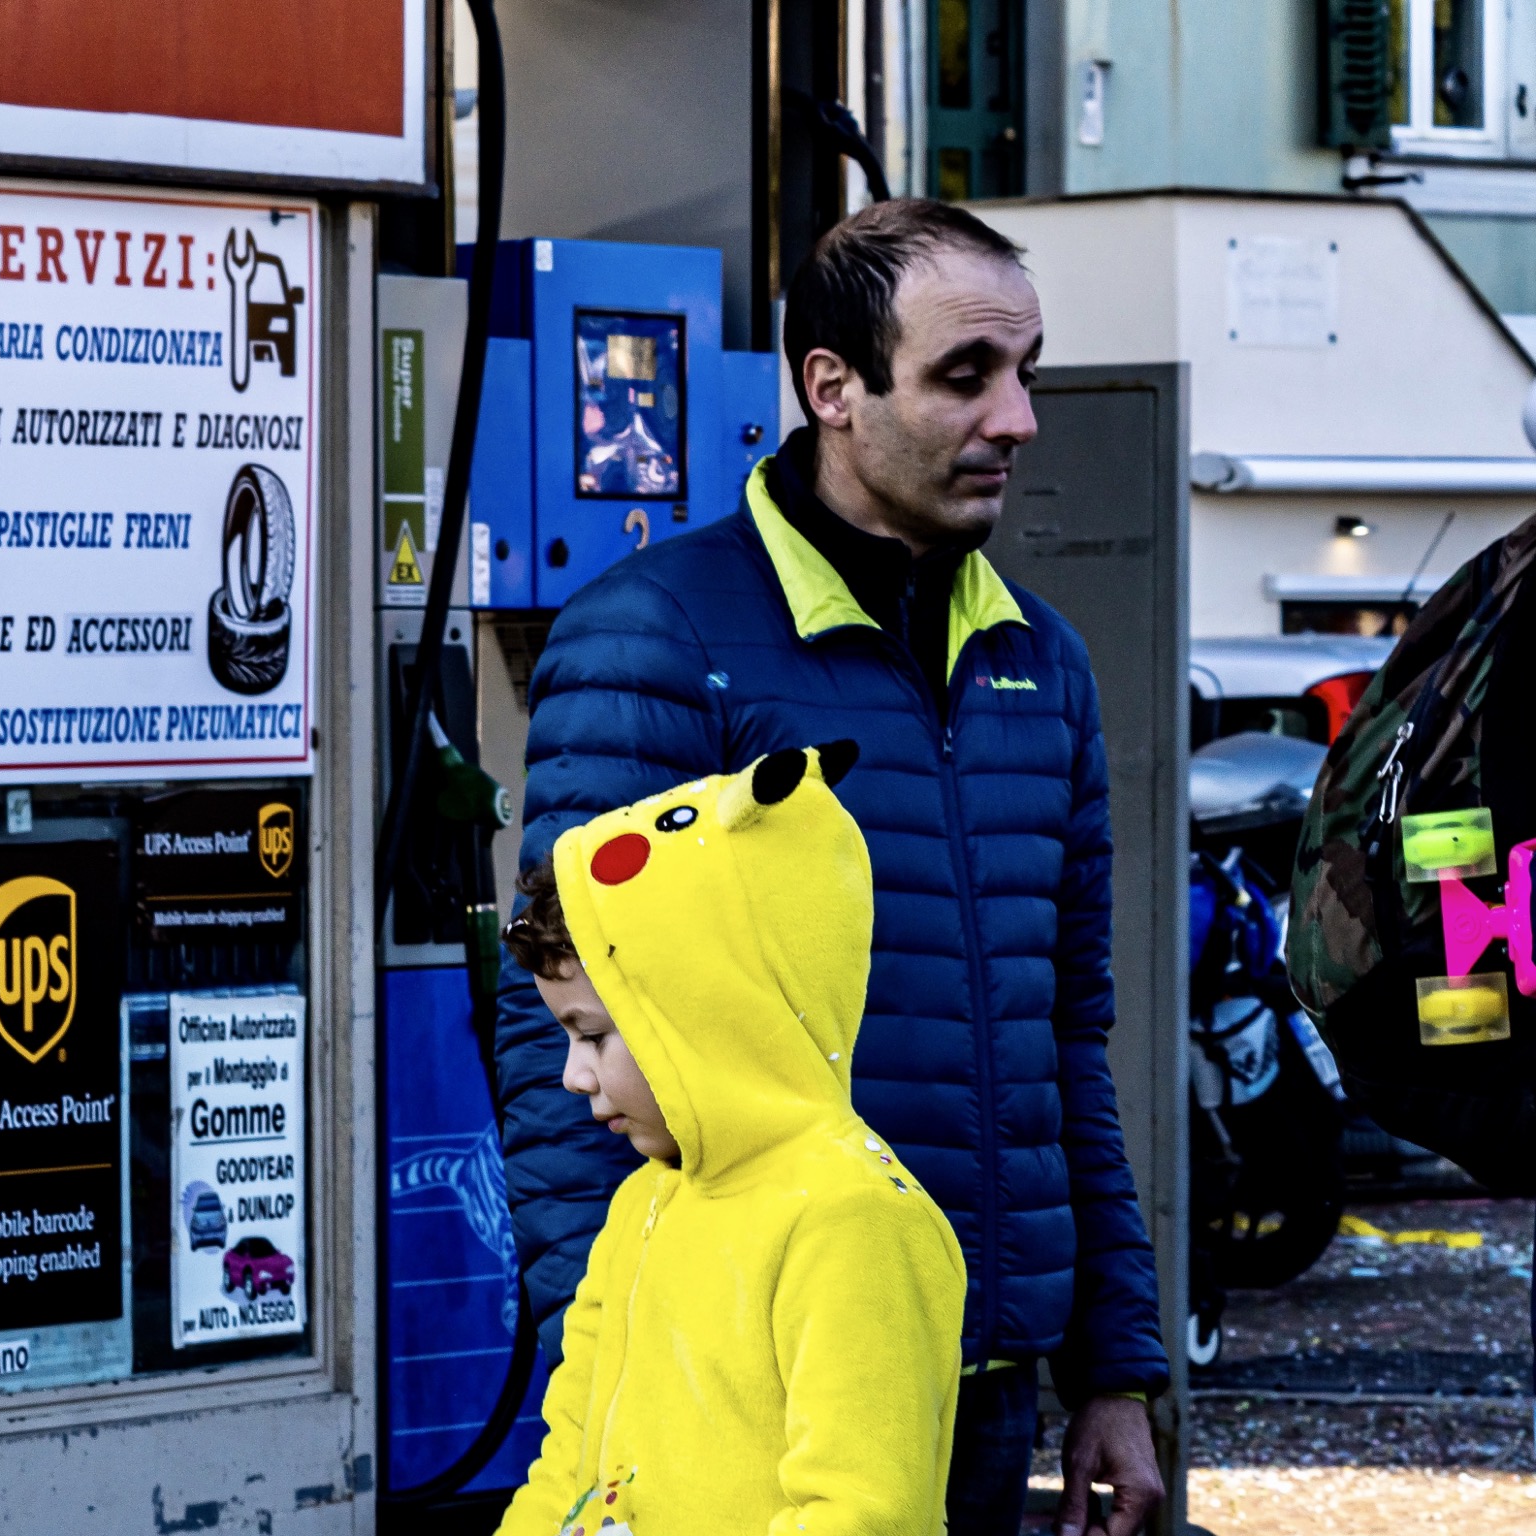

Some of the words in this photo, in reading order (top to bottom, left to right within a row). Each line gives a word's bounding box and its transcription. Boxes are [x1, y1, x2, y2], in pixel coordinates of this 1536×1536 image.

[55, 324, 223, 367] CONDIZIONATA
[12, 408, 162, 449] AUTORIZZATI
[172, 413, 187, 450] E
[196, 414, 303, 451] DIAGNOSI
[122, 513, 192, 550] FRENI
[396, 562, 415, 580] EX
[24, 615, 56, 653] ED
[66, 616, 193, 654] ACCESSORI
[165, 703, 303, 743] PNEUMATICI
[144, 832, 171, 856] UPS
[172, 832, 214, 855] Access
[214, 830, 250, 853] Point
[262, 827, 292, 866] ups
[178, 1015, 227, 1044] Officina
[229, 1012, 297, 1041] Autorizzata
[187, 1069, 202, 1091] per
[212, 1056, 279, 1089] Montaggio
[61, 1092, 112, 1125] Point
[190, 1098, 286, 1138] Gomme
[216, 1154, 295, 1185] GOODYEAR
[32, 1204, 95, 1235] barcode
[238, 1194, 295, 1223] DUNLOP
[39, 1241, 101, 1273] enabled
[199, 1306, 229, 1330] AUTO
[239, 1300, 296, 1326] NOLEGGIO
